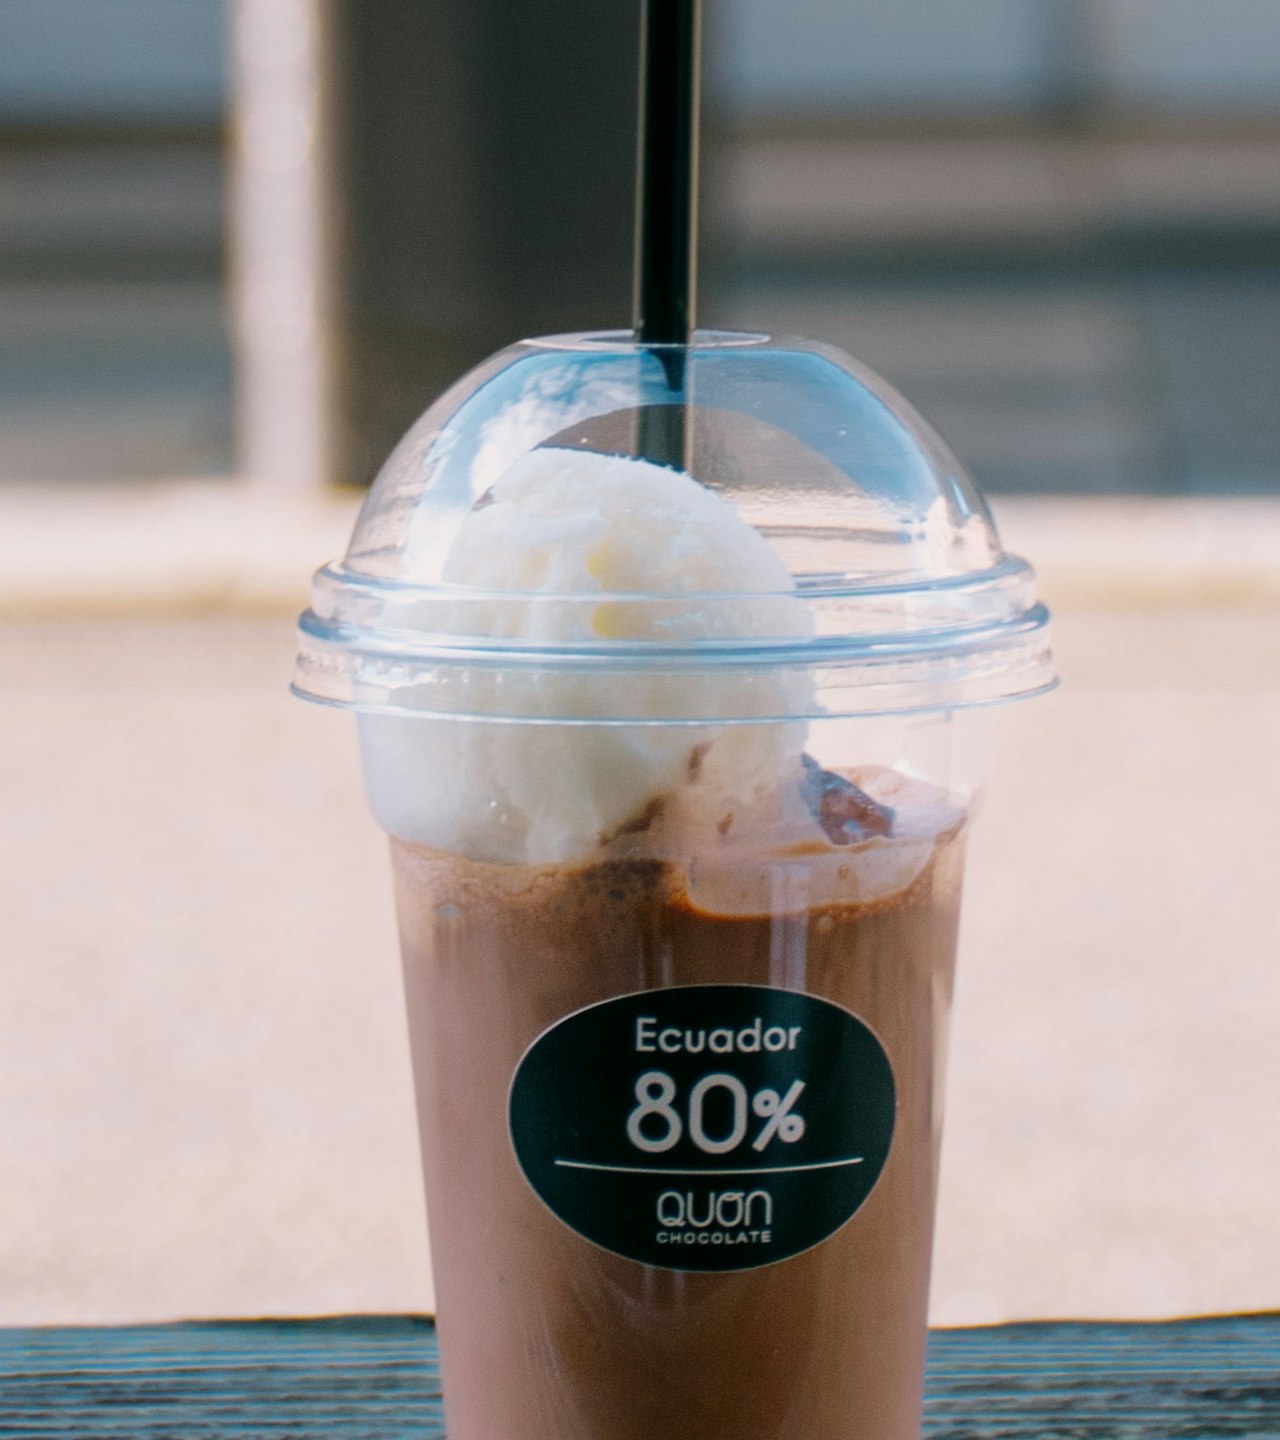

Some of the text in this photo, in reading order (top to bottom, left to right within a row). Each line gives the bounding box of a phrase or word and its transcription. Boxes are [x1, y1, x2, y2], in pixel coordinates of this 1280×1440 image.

[635, 1017, 803, 1054] Ecuador
[626, 1071, 807, 1154] 80%
[656, 1230, 773, 1245] CHOCOLATE
